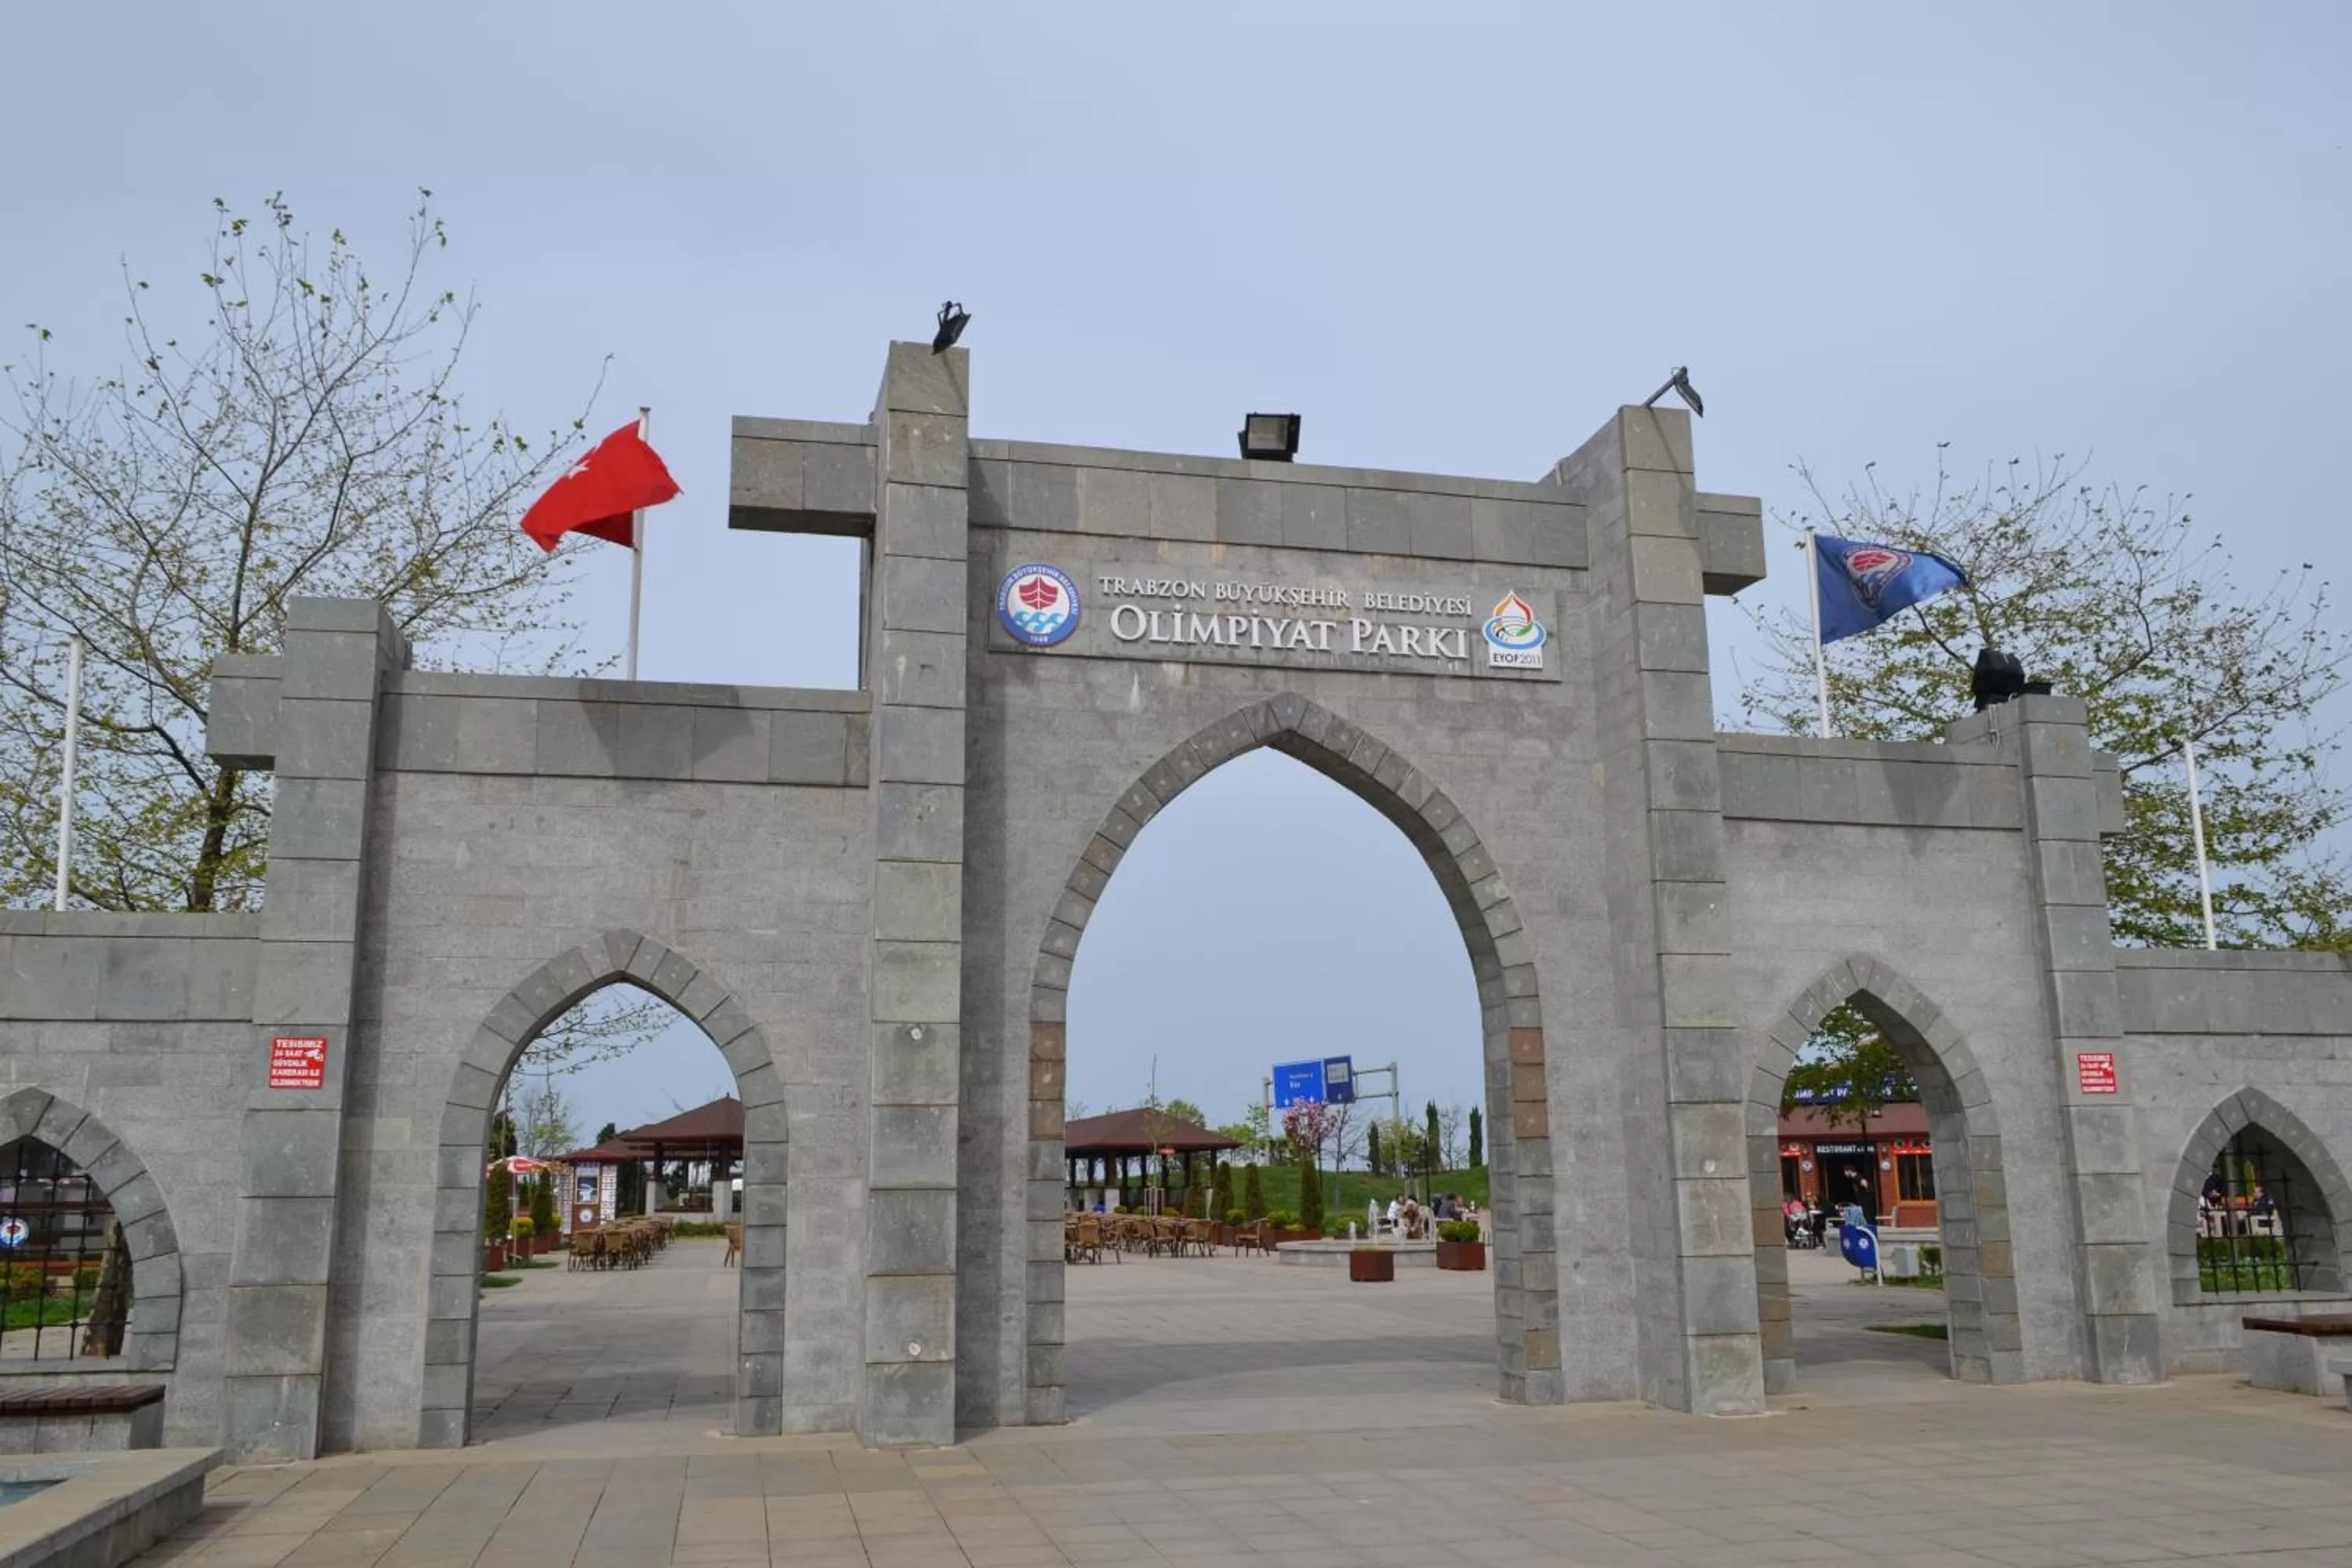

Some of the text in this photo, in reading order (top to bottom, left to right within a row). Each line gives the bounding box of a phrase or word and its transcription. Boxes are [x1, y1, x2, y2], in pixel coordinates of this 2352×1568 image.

[1098, 576, 1472, 615] TRABZON BÜYÜKŞEHİR BELEDİYESİ
[1110, 603, 1468, 659] OLİMPİYAT PARKI
